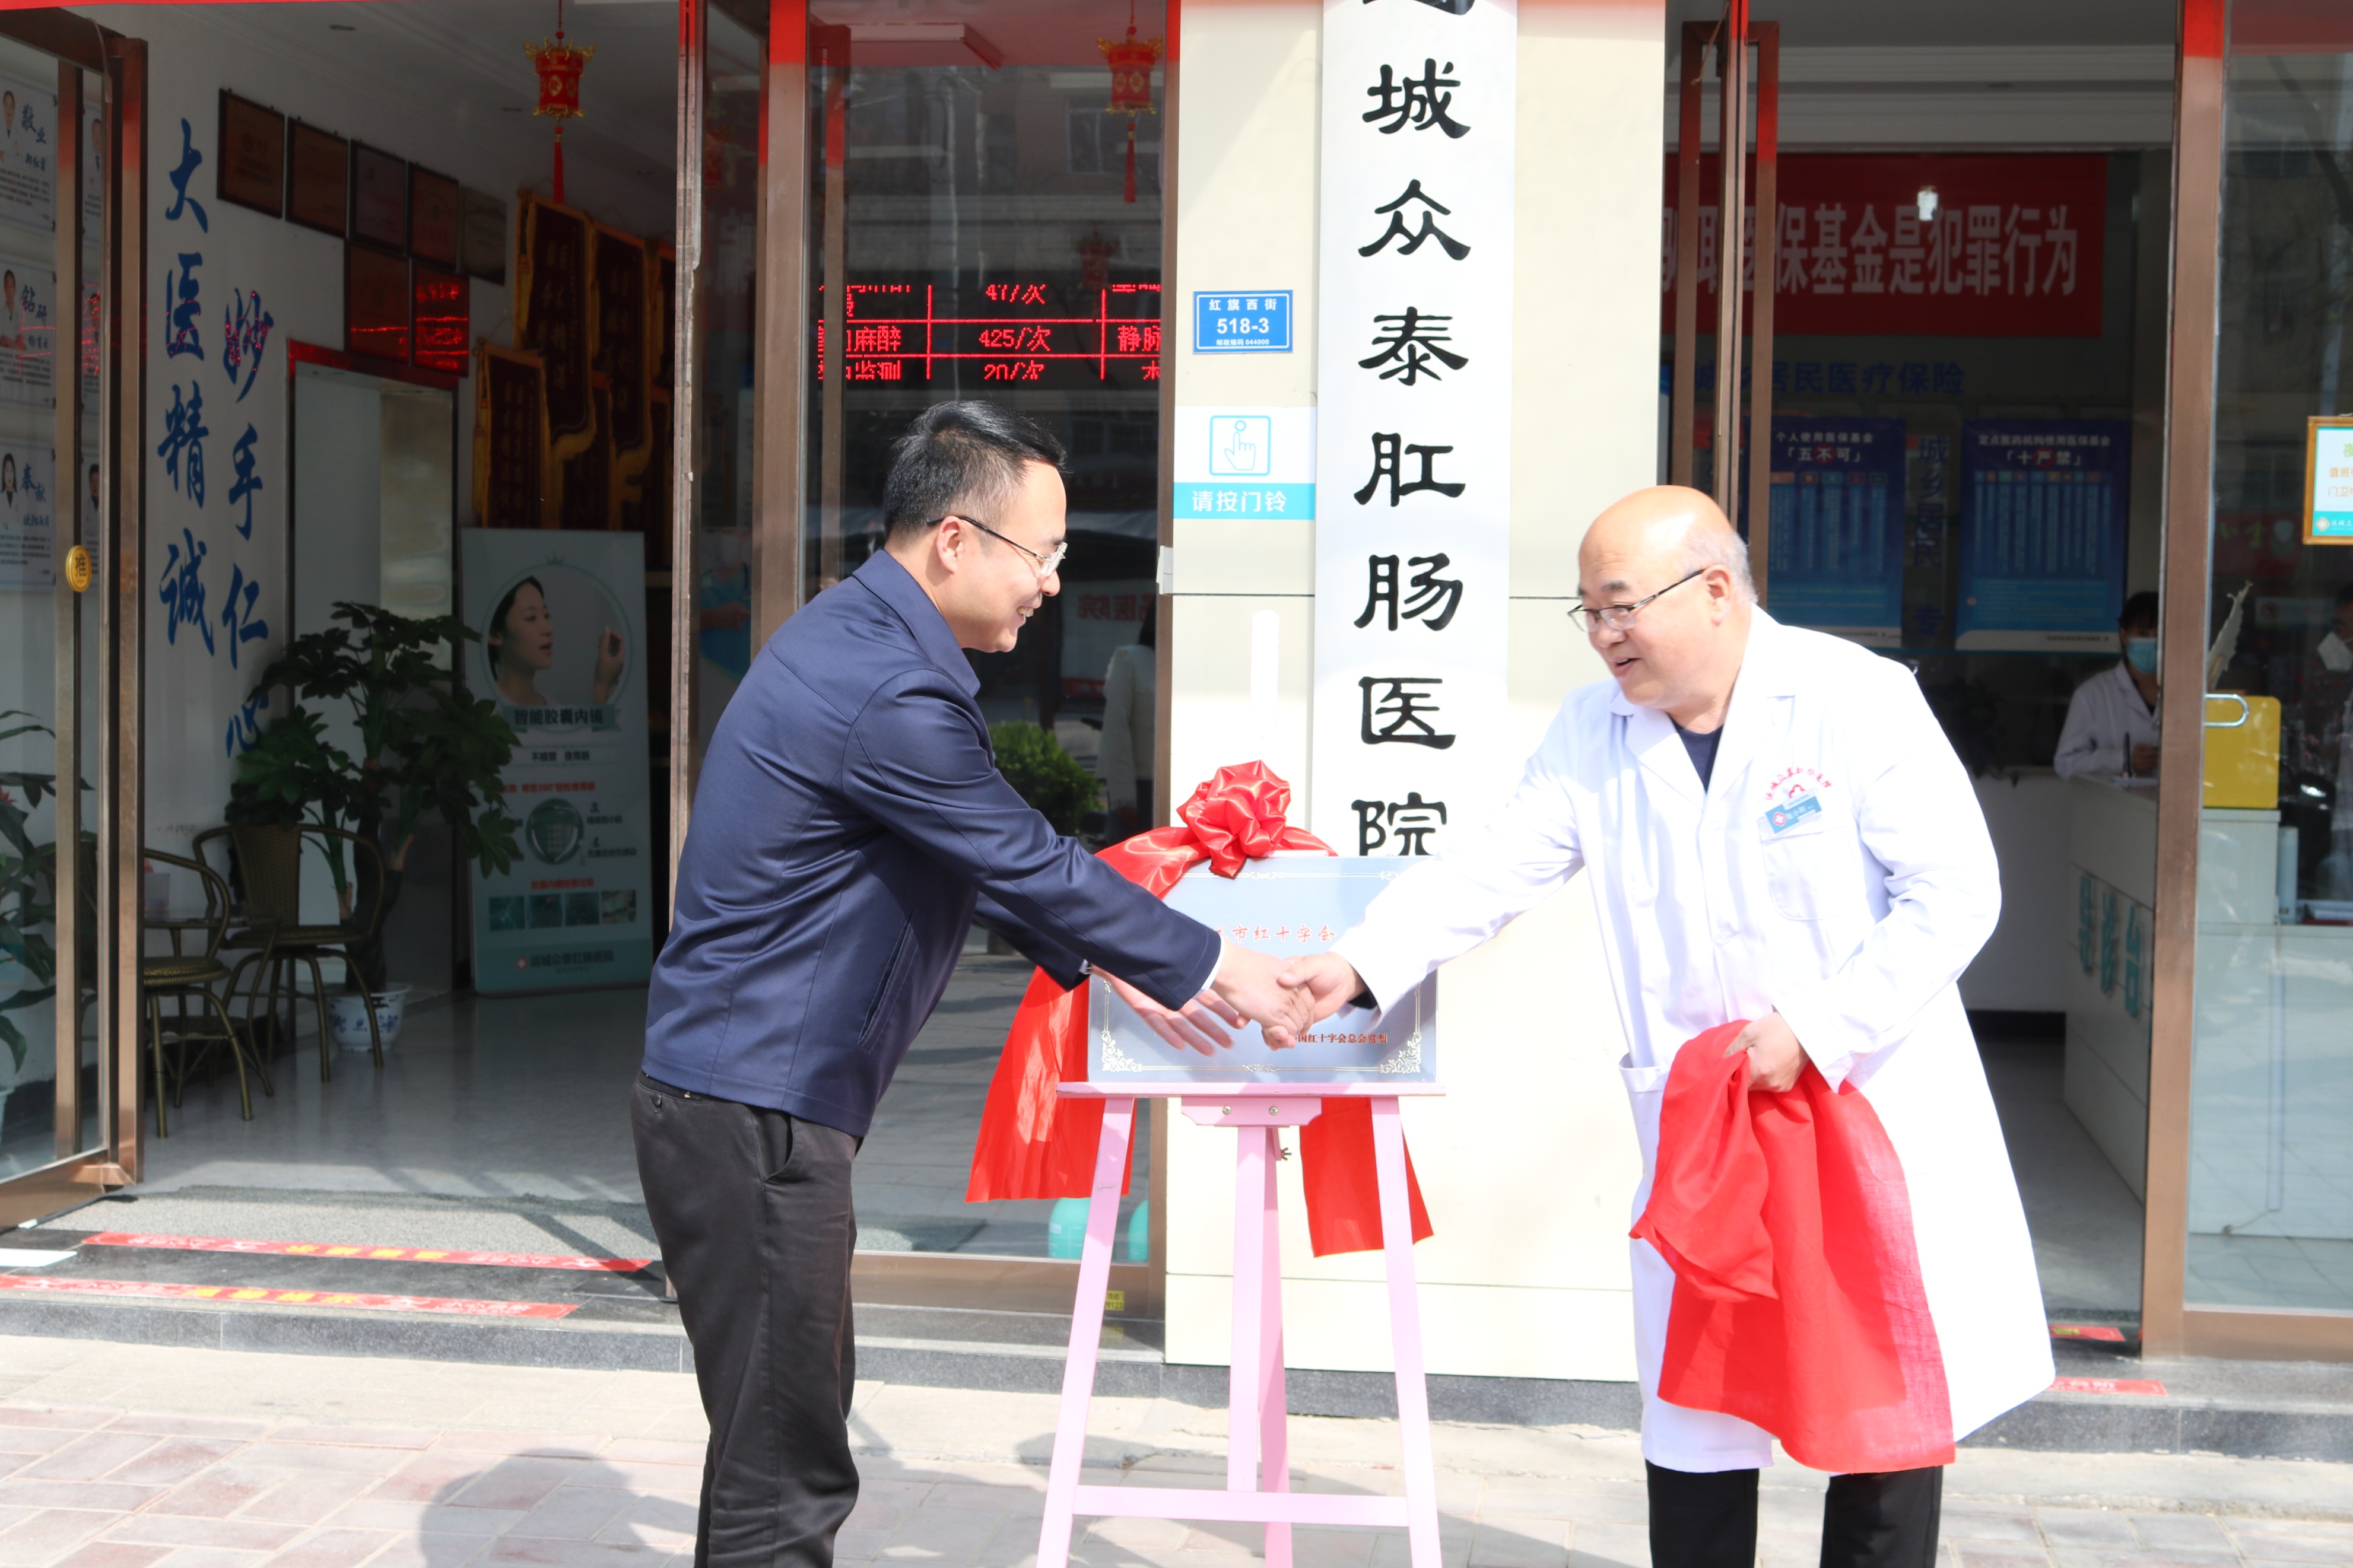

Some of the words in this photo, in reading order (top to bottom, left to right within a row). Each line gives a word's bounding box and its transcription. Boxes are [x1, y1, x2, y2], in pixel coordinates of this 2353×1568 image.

[20, 284, 47, 325] 钻研
[1209, 298, 1277, 311] 红旗西街
[1217, 317, 1270, 334] 518-3
[846, 326, 901, 352] 麻醉
[979, 325, 1051, 351] 425/次
[846, 360, 901, 380] 监测
[157, 118, 214, 656] 大医精诚
[1352, 0, 1475, 856] 城众泰肛肠医院
[1776, 432, 1873, 444] 个人使用医保基金
[1978, 435, 2111, 446] 定点医药机构使用医保基金
[21, 462, 47, 503] 奉献
[1192, 491, 1287, 513] 请按门铃
[221, 287, 274, 759] 妙手仁心
[75, 553, 87, 577] 推
[514, 708, 604, 726] 智能胶囊内镜
[1295, 1033, 1387, 1044] 国红十字会总会监制
